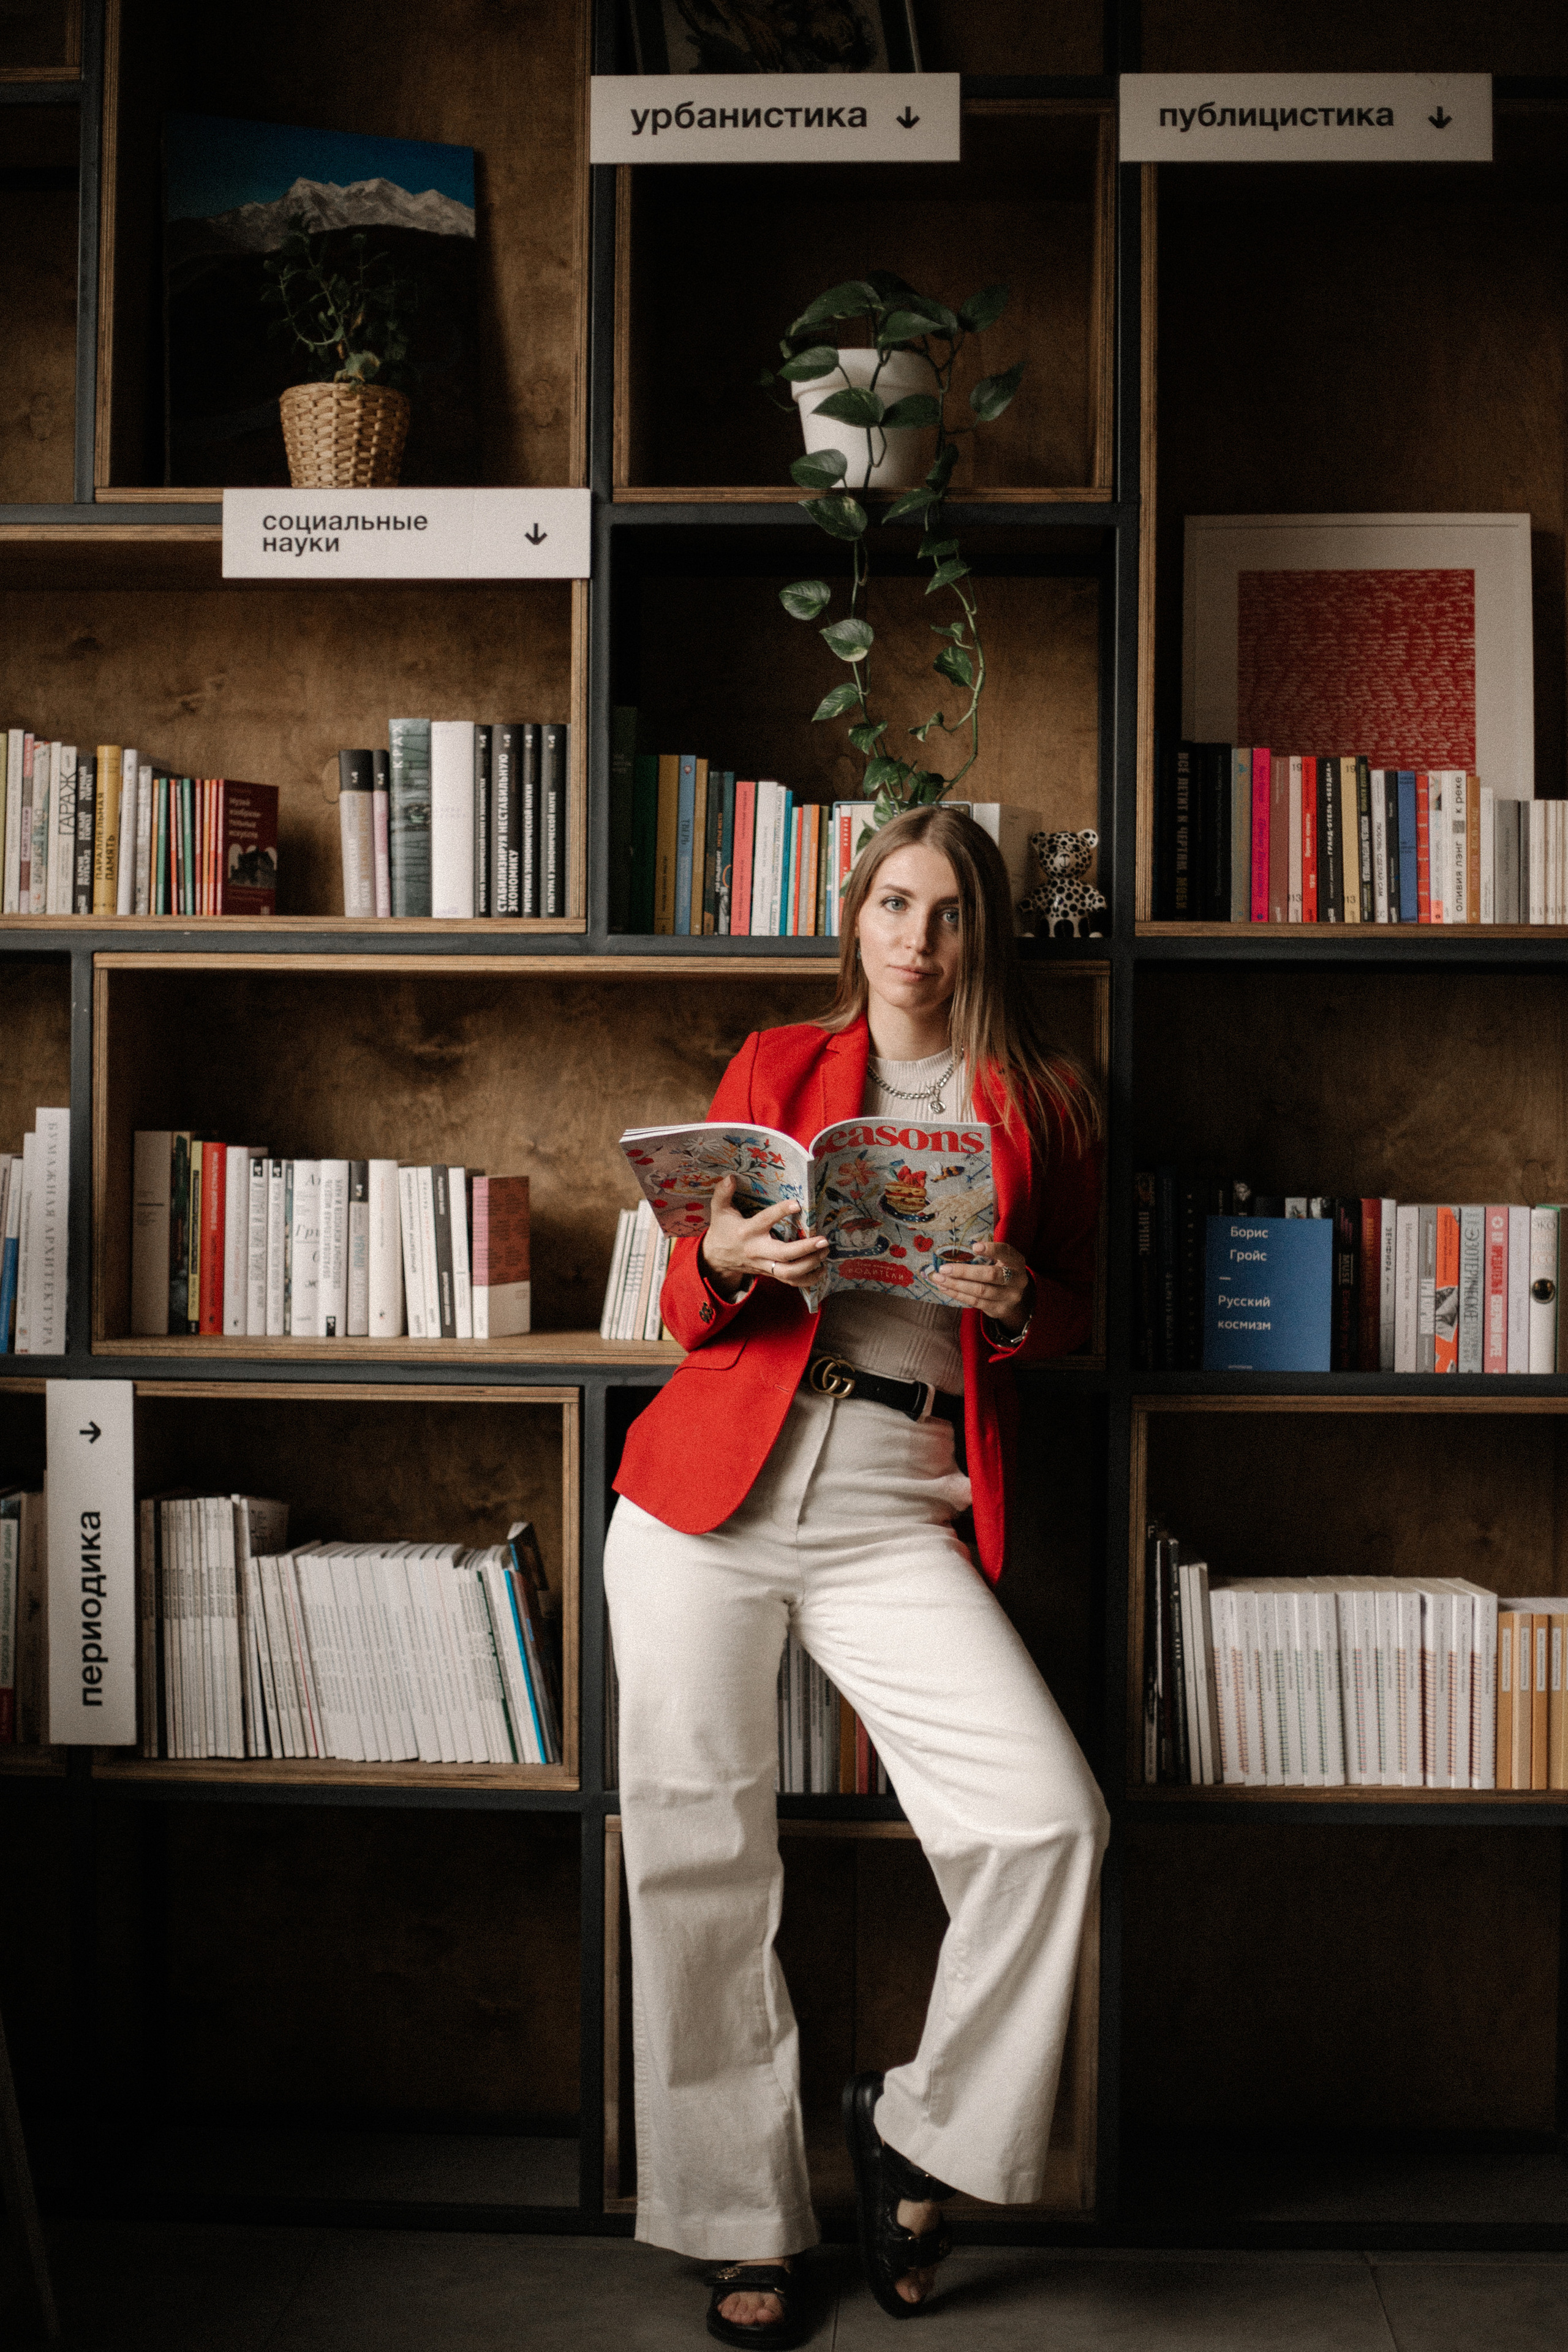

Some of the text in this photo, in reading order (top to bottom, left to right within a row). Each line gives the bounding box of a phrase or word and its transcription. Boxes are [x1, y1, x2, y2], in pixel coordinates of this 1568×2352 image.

[631, 102, 867, 135] урбанистика
[1159, 102, 1394, 132] публицистика
[263, 516, 428, 535] социальные
[263, 537, 339, 557] науки
[393, 725, 403, 769] КРАХ
[58, 771, 75, 835] ГАРАЖ
[1454, 777, 1464, 804] реке
[96, 793, 105, 881] ПАРАЛЛЕЛЬНАЯ
[497, 753, 508, 912] СТАБИЛИЗИРУЯ НЕСТАБИЛЬНУЮ
[105, 835, 115, 881] ПАМЯТЬ
[508, 850, 519, 912] ЭКОНОМИКУ
[42, 1121, 58, 1345] БУМАЖНАЯ АРХИТЕКТУРА
[1231, 1226, 1269, 1240] Борис
[353, 1235, 364, 1268] ПРАВА
[1230, 1249, 1268, 1262] Гройс
[1490, 1245, 1503, 1287] ПРЕДАТЕЛЬ
[848, 1268, 904, 1281] РОДИТЕЛИ
[1341, 1254, 1351, 1284] MUSE
[1218, 1295, 1272, 1308] Русский
[1218, 1321, 1272, 1331] космизм
[80, 1511, 109, 1707] периодика
